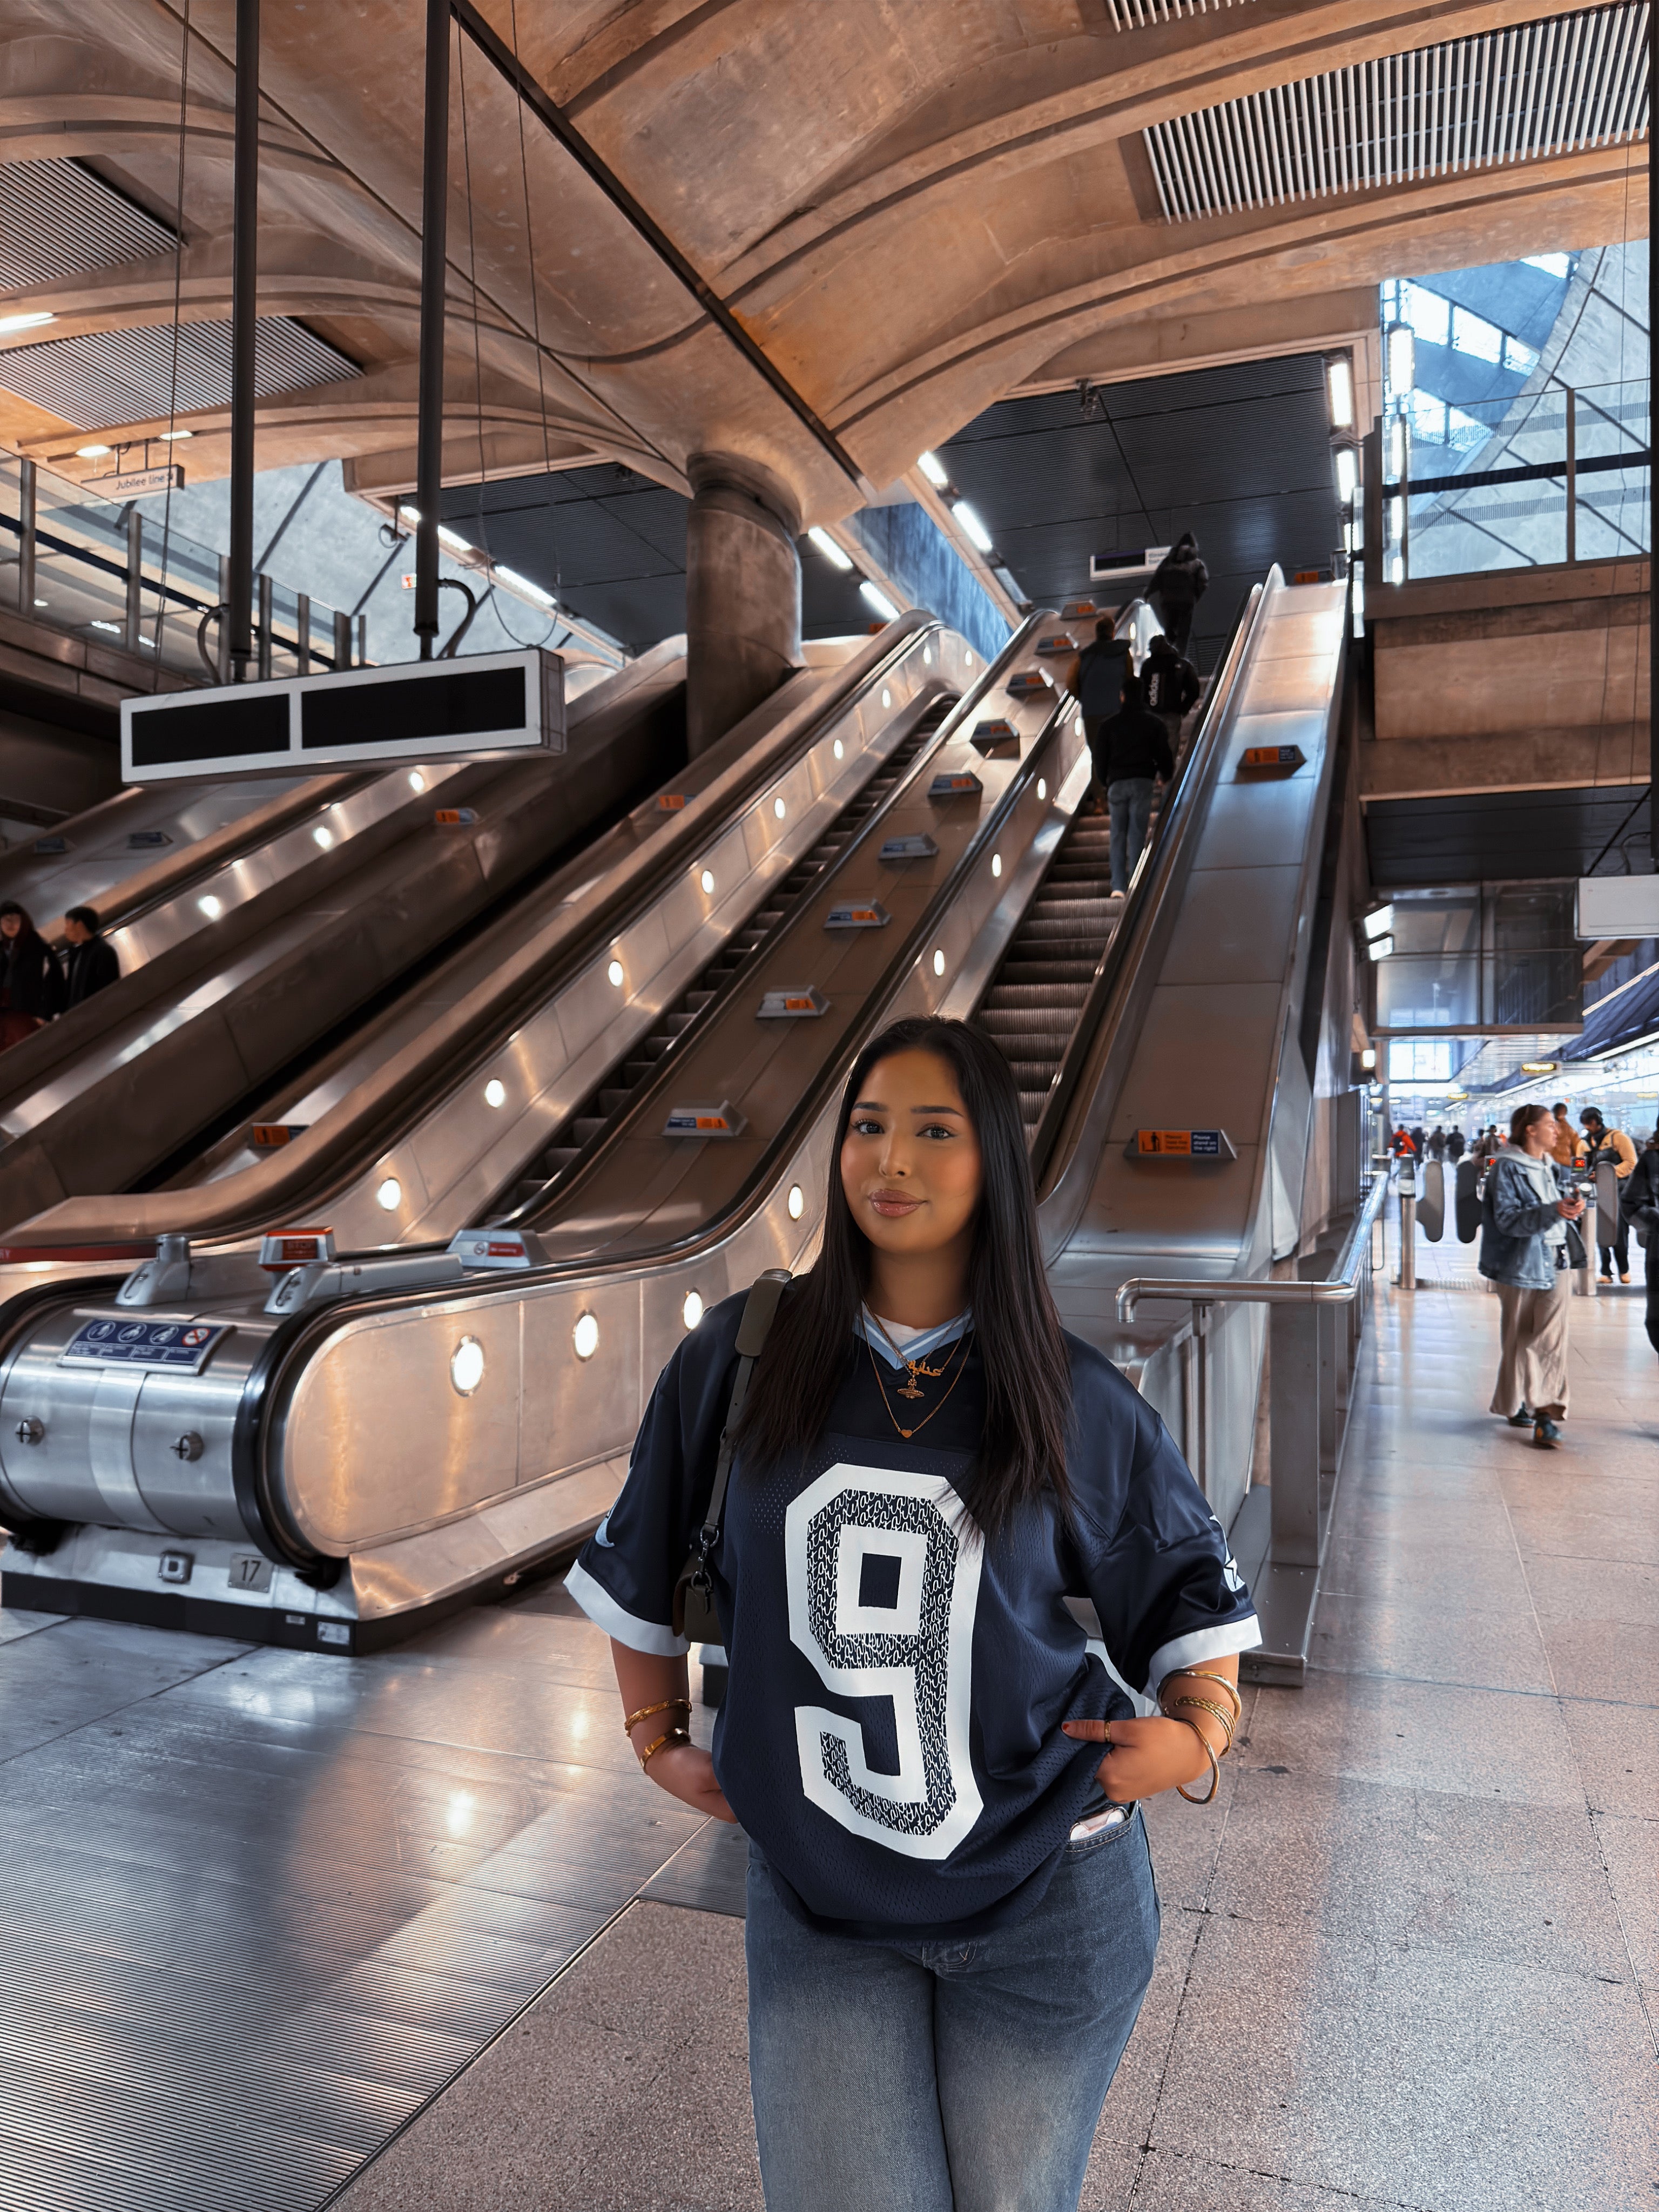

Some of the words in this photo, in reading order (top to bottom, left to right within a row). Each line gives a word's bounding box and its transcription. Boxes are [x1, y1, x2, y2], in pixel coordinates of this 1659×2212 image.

[116, 478, 146, 490] Jubilee
[241, 1559, 262, 1582] 17
[785, 1462, 984, 1859] 9
